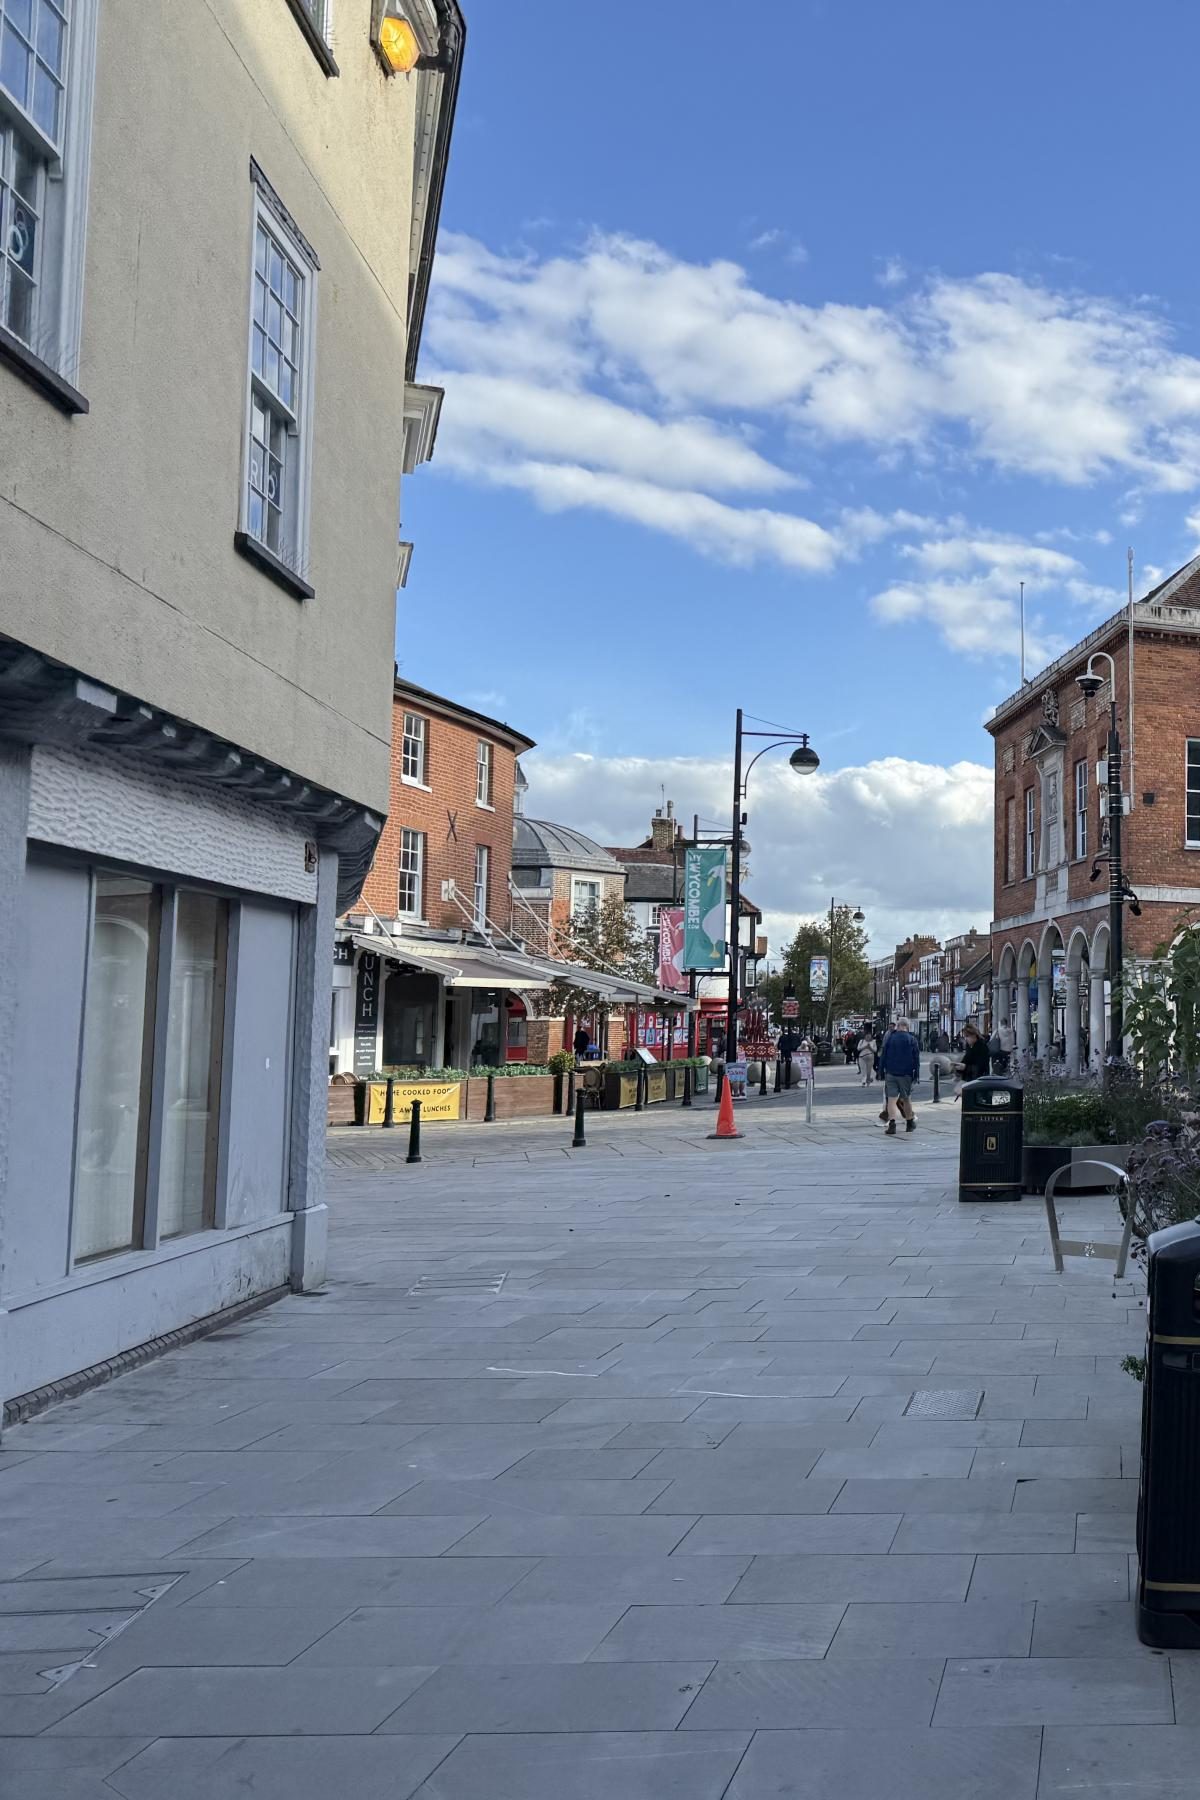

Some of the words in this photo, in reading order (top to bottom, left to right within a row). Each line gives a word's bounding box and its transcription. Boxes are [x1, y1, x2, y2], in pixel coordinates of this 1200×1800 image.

[688, 862, 701, 923] WYCOMBE
[361, 955, 375, 1017] UNCH
[423, 1104, 451, 1113] LUNCHES
